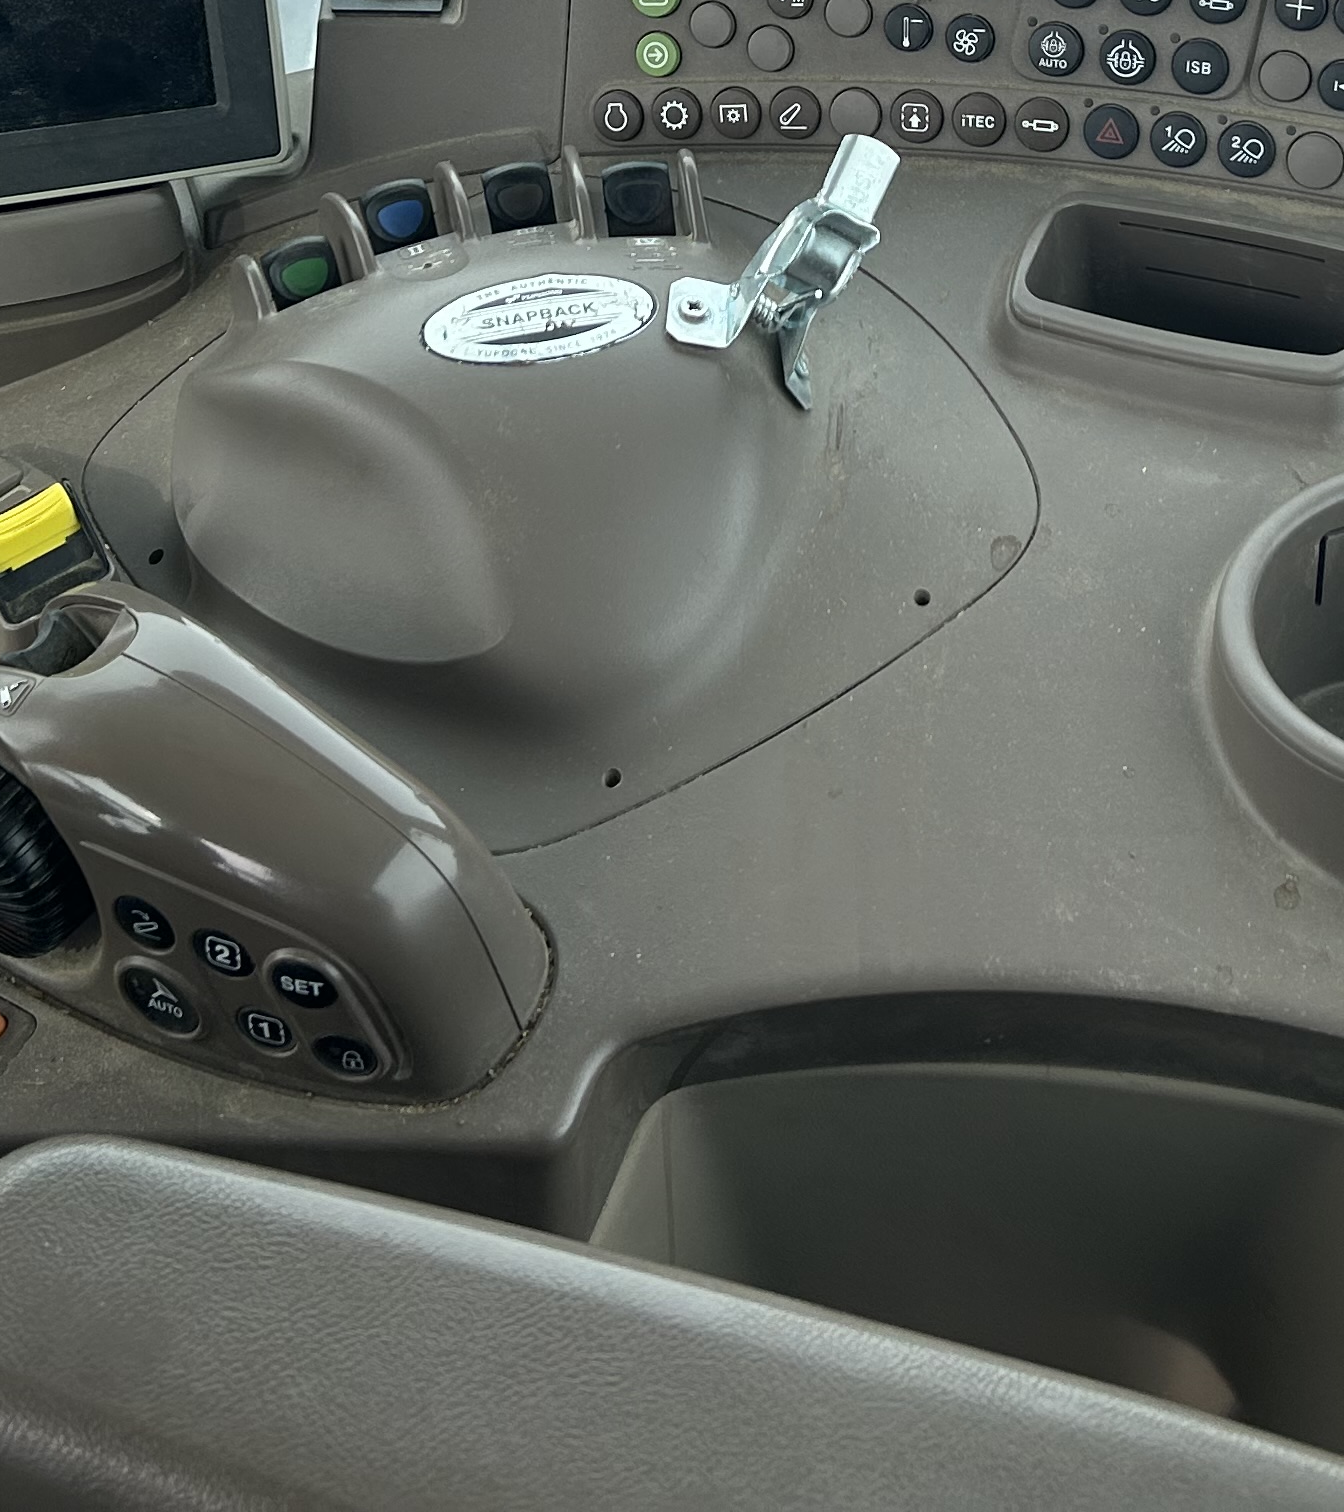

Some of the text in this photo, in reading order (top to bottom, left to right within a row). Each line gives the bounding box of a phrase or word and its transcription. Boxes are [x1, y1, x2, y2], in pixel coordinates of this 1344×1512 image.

[1038, 57, 1068, 69] AUTO
[1185, 60, 1212, 76] ISB
[961, 114, 995, 129] iTEC
[1164, 125, 1172, 138] 1
[1231, 136, 1241, 149] 2
[511, 277, 589, 292] AUTHENTIC
[481, 300, 598, 330] SNAPBACK
[215, 944, 232, 964] 2
[281, 975, 325, 997] SET
[147, 998, 183, 1019] AUTO
[260, 1021, 272, 1039] 1
